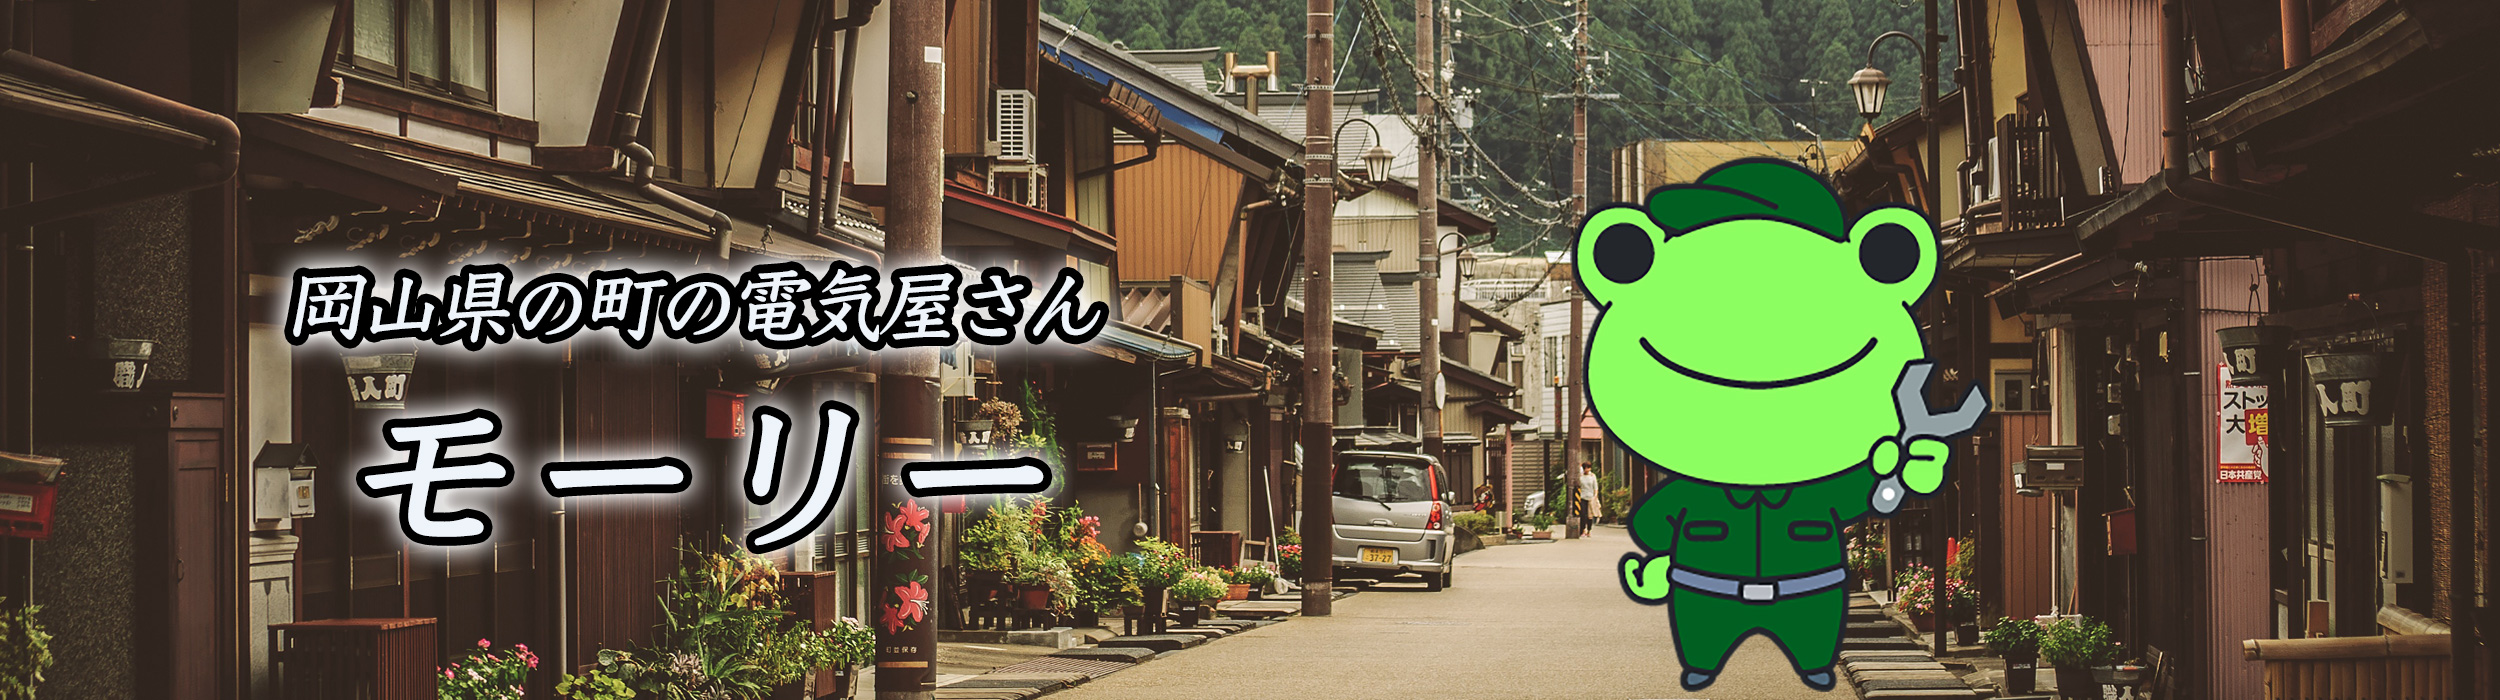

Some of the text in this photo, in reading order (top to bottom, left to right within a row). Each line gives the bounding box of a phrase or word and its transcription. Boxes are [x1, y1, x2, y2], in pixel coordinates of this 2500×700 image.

[2220, 470, 2262, 480] 日本共産党
[1370, 553, 1391, 563] 37-27
